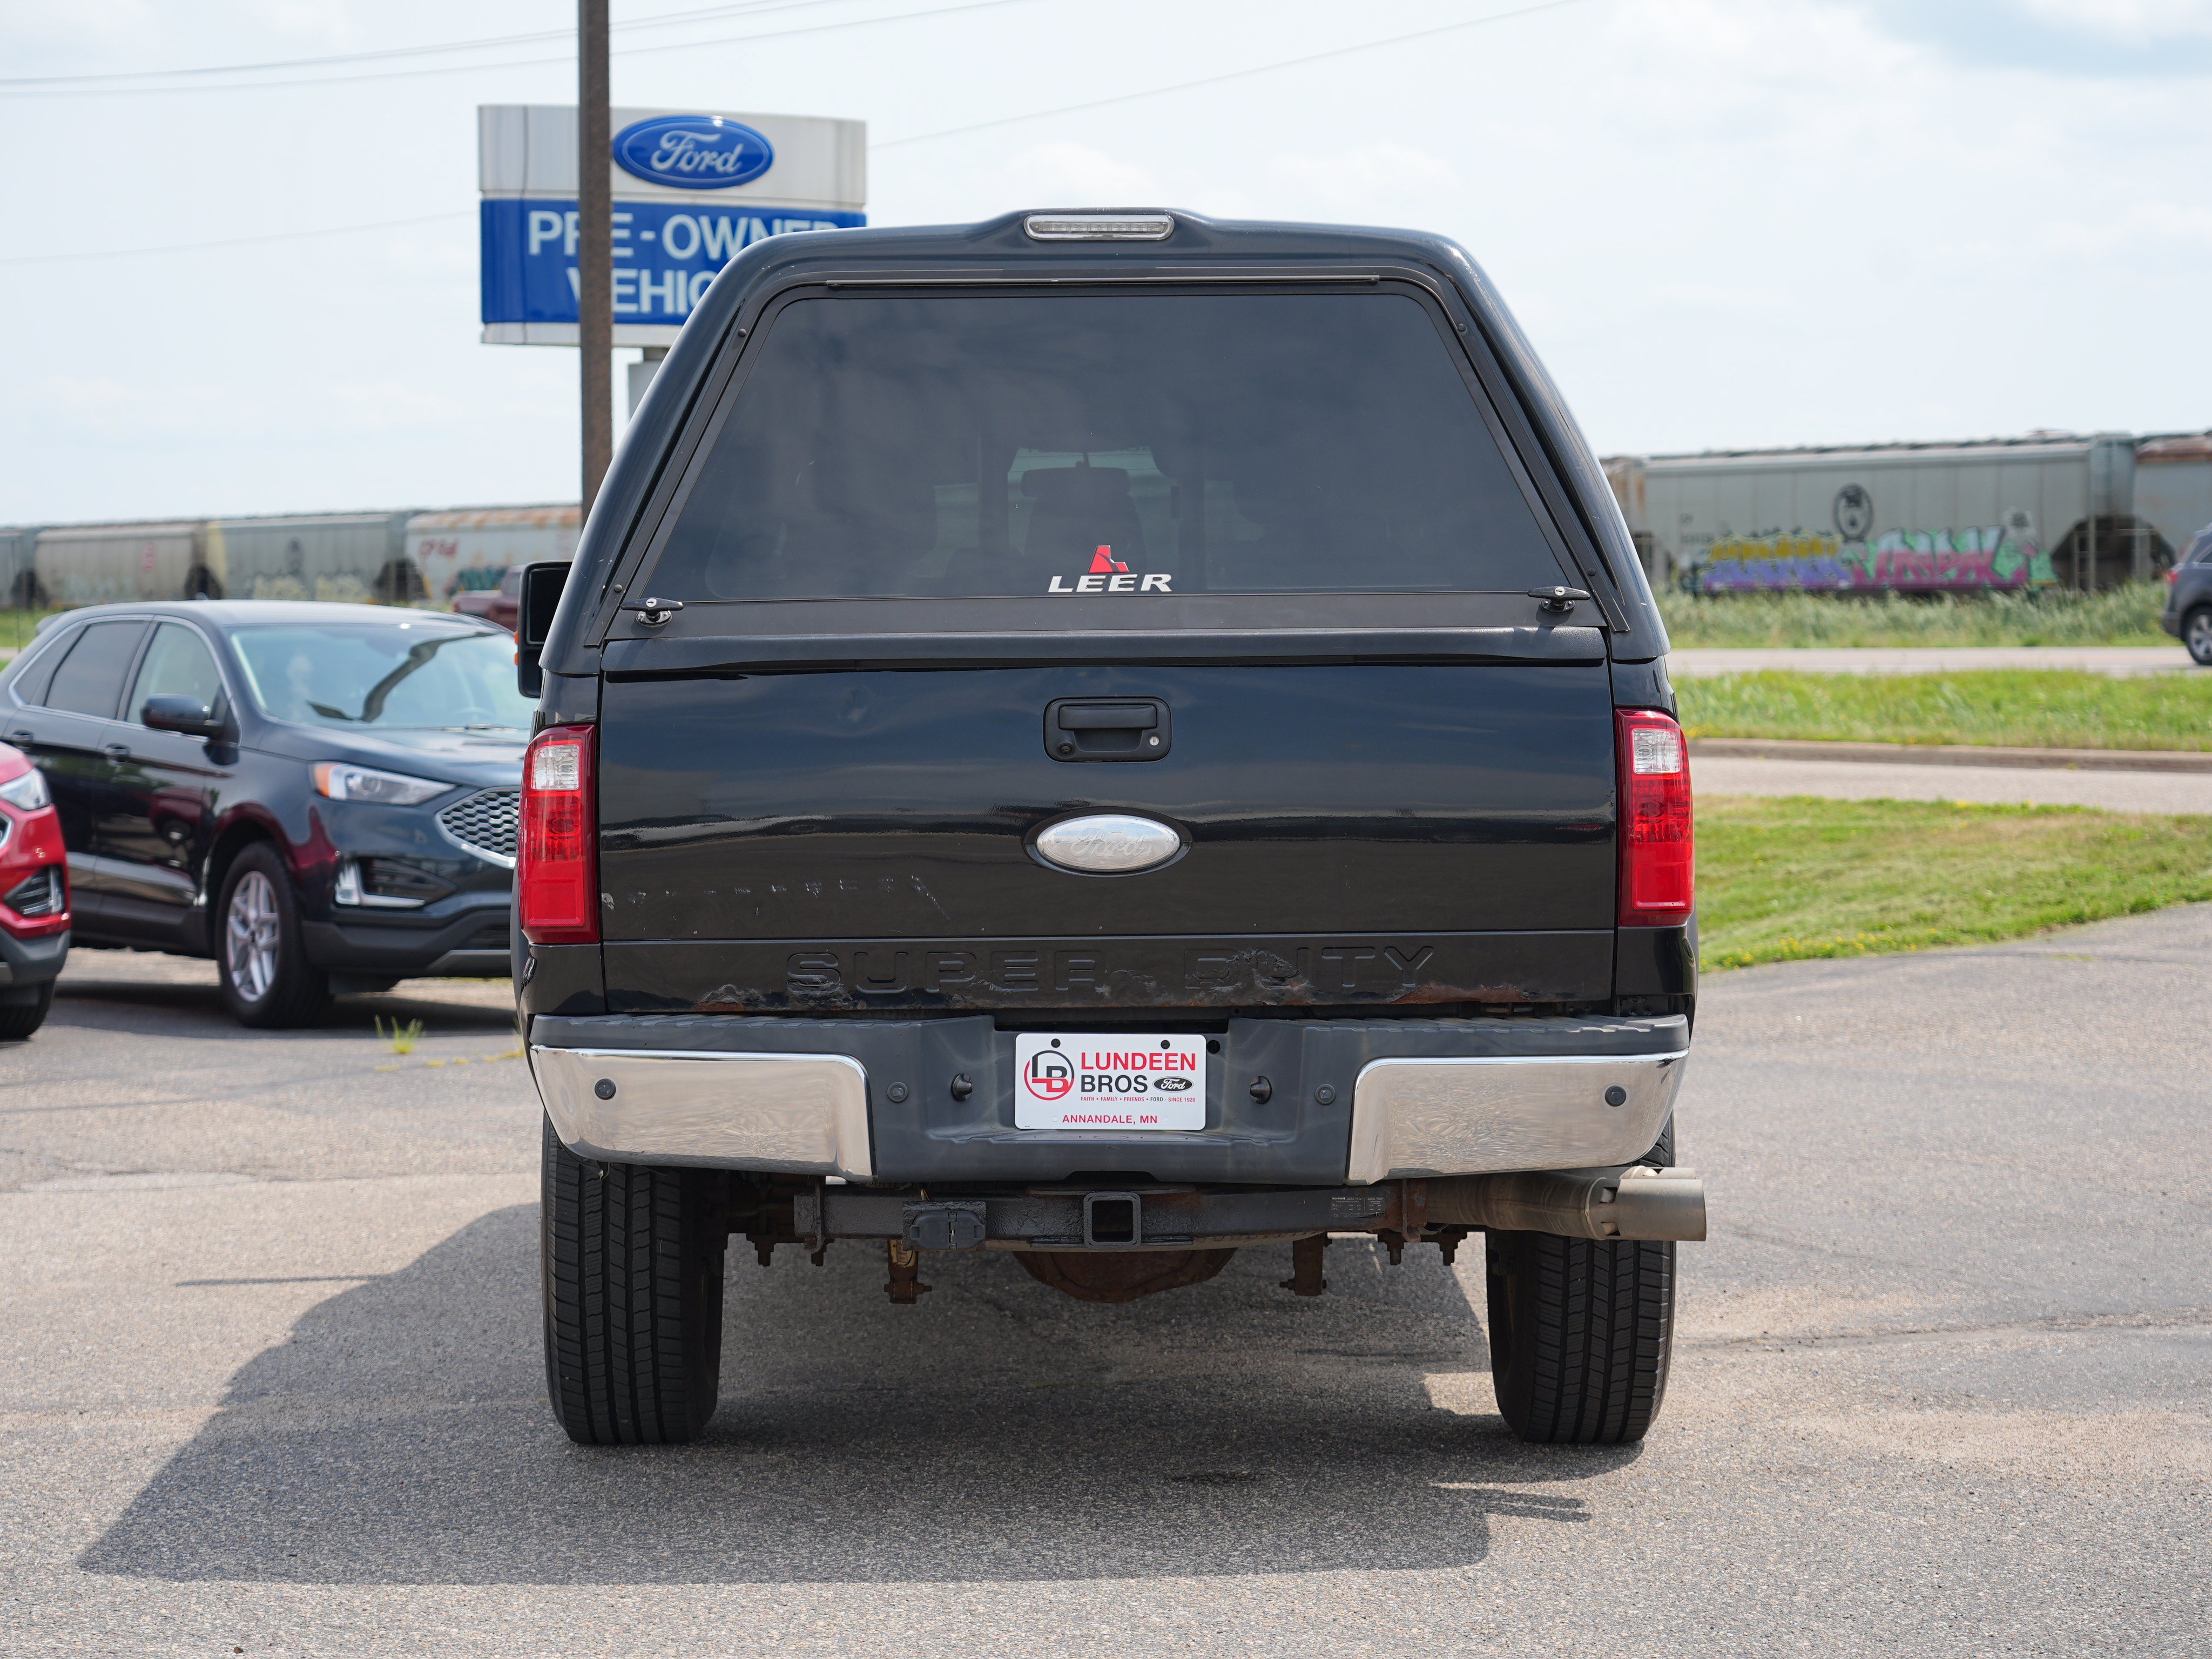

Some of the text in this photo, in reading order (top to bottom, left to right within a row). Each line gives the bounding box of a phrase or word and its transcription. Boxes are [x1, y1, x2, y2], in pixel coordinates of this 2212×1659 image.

[650, 130, 743, 174] Ford
[1048, 574, 1172, 593] LEER
[1070, 827, 1146, 858] Ford
[786, 946, 1435, 994] SUPER DUTY
[1081, 1052, 1196, 1071] LUNDEEN
[1081, 1075, 1148, 1093] BROS
[1062, 1115, 1158, 1125] ANNANDALE, MN
